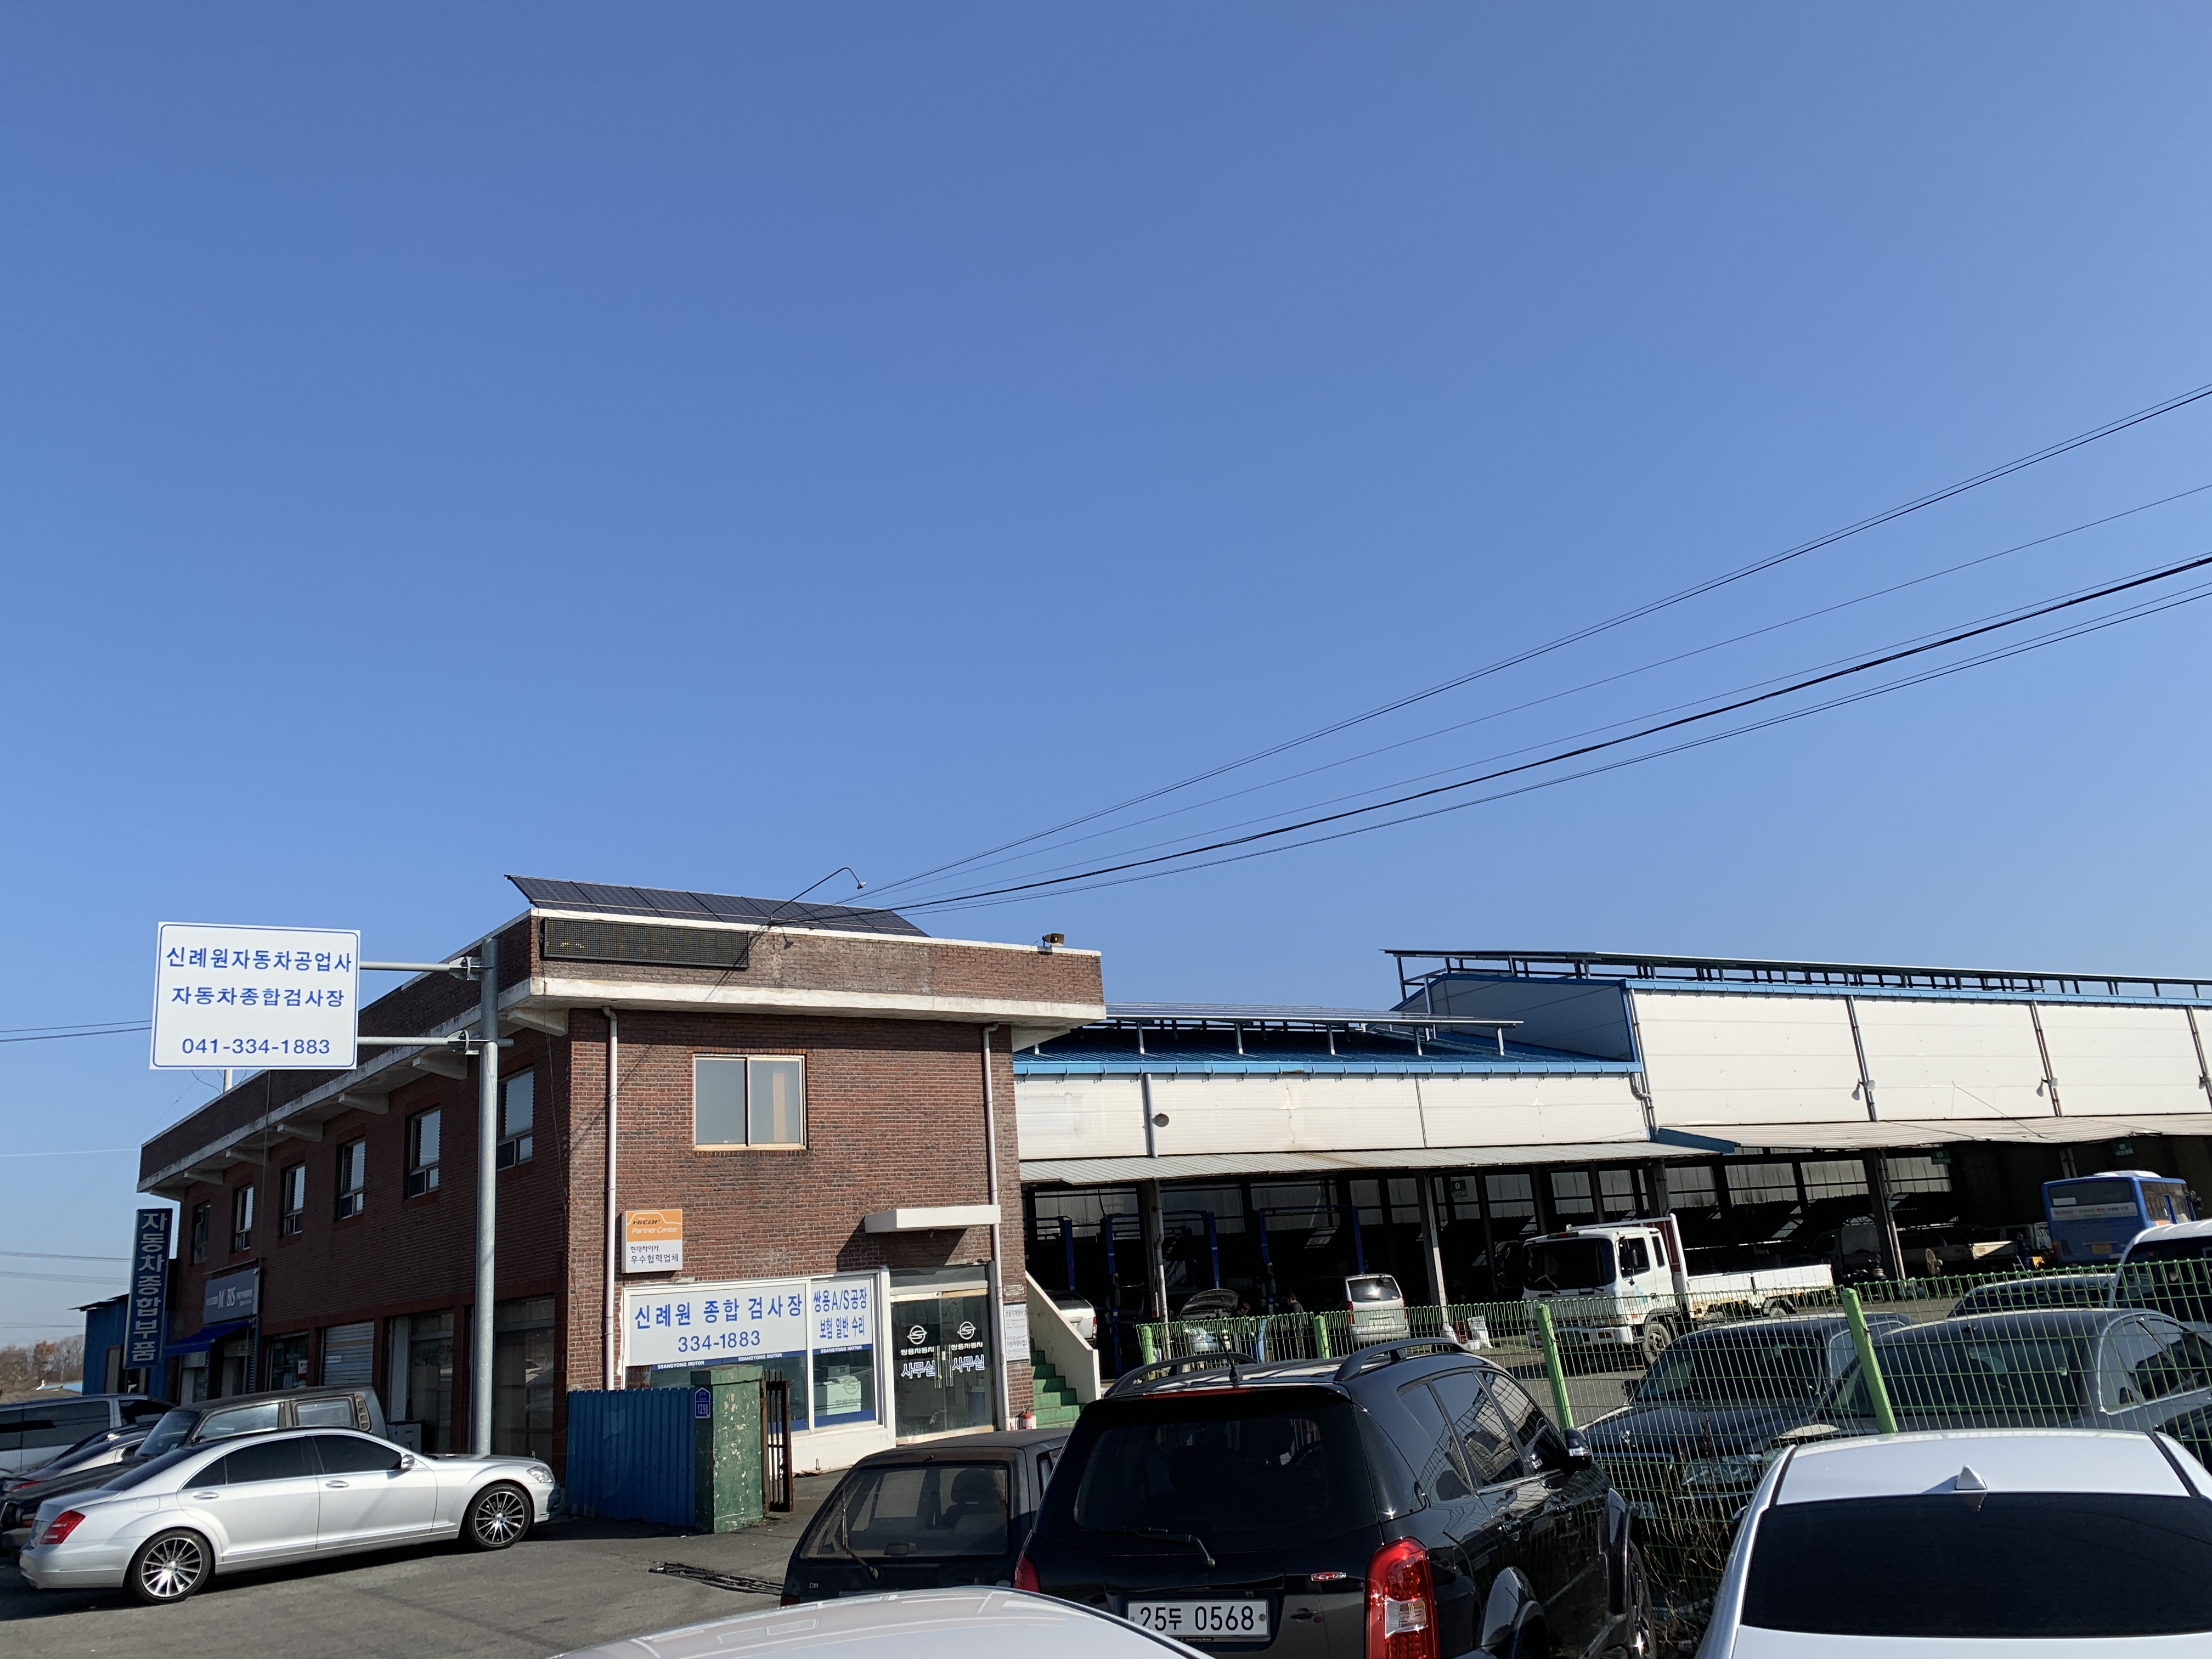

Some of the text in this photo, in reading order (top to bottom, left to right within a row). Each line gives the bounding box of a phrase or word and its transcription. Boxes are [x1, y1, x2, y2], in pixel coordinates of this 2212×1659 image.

[166, 947, 351, 972] 신례원자동차공업사
[171, 986, 344, 1007] 자동차종합검사장
[182, 1039, 330, 1054] 041-334-1883
[630, 1254, 679, 1264] 우수협력업체
[131, 1213, 167, 1362] 자동차종합부품
[813, 1287, 867, 1312] 쌍용A/S공장
[635, 1302, 691, 1329] 신례원
[820, 1314, 865, 1339] 보험 일반 수리
[678, 1330, 760, 1352] 334-1883
[951, 1341, 983, 1351] 쌍용자동차
[901, 1360, 936, 1379] 사무실
[952, 1354, 985, 1373] 사무실
[1139, 1606, 1254, 1631] 25두 0568
